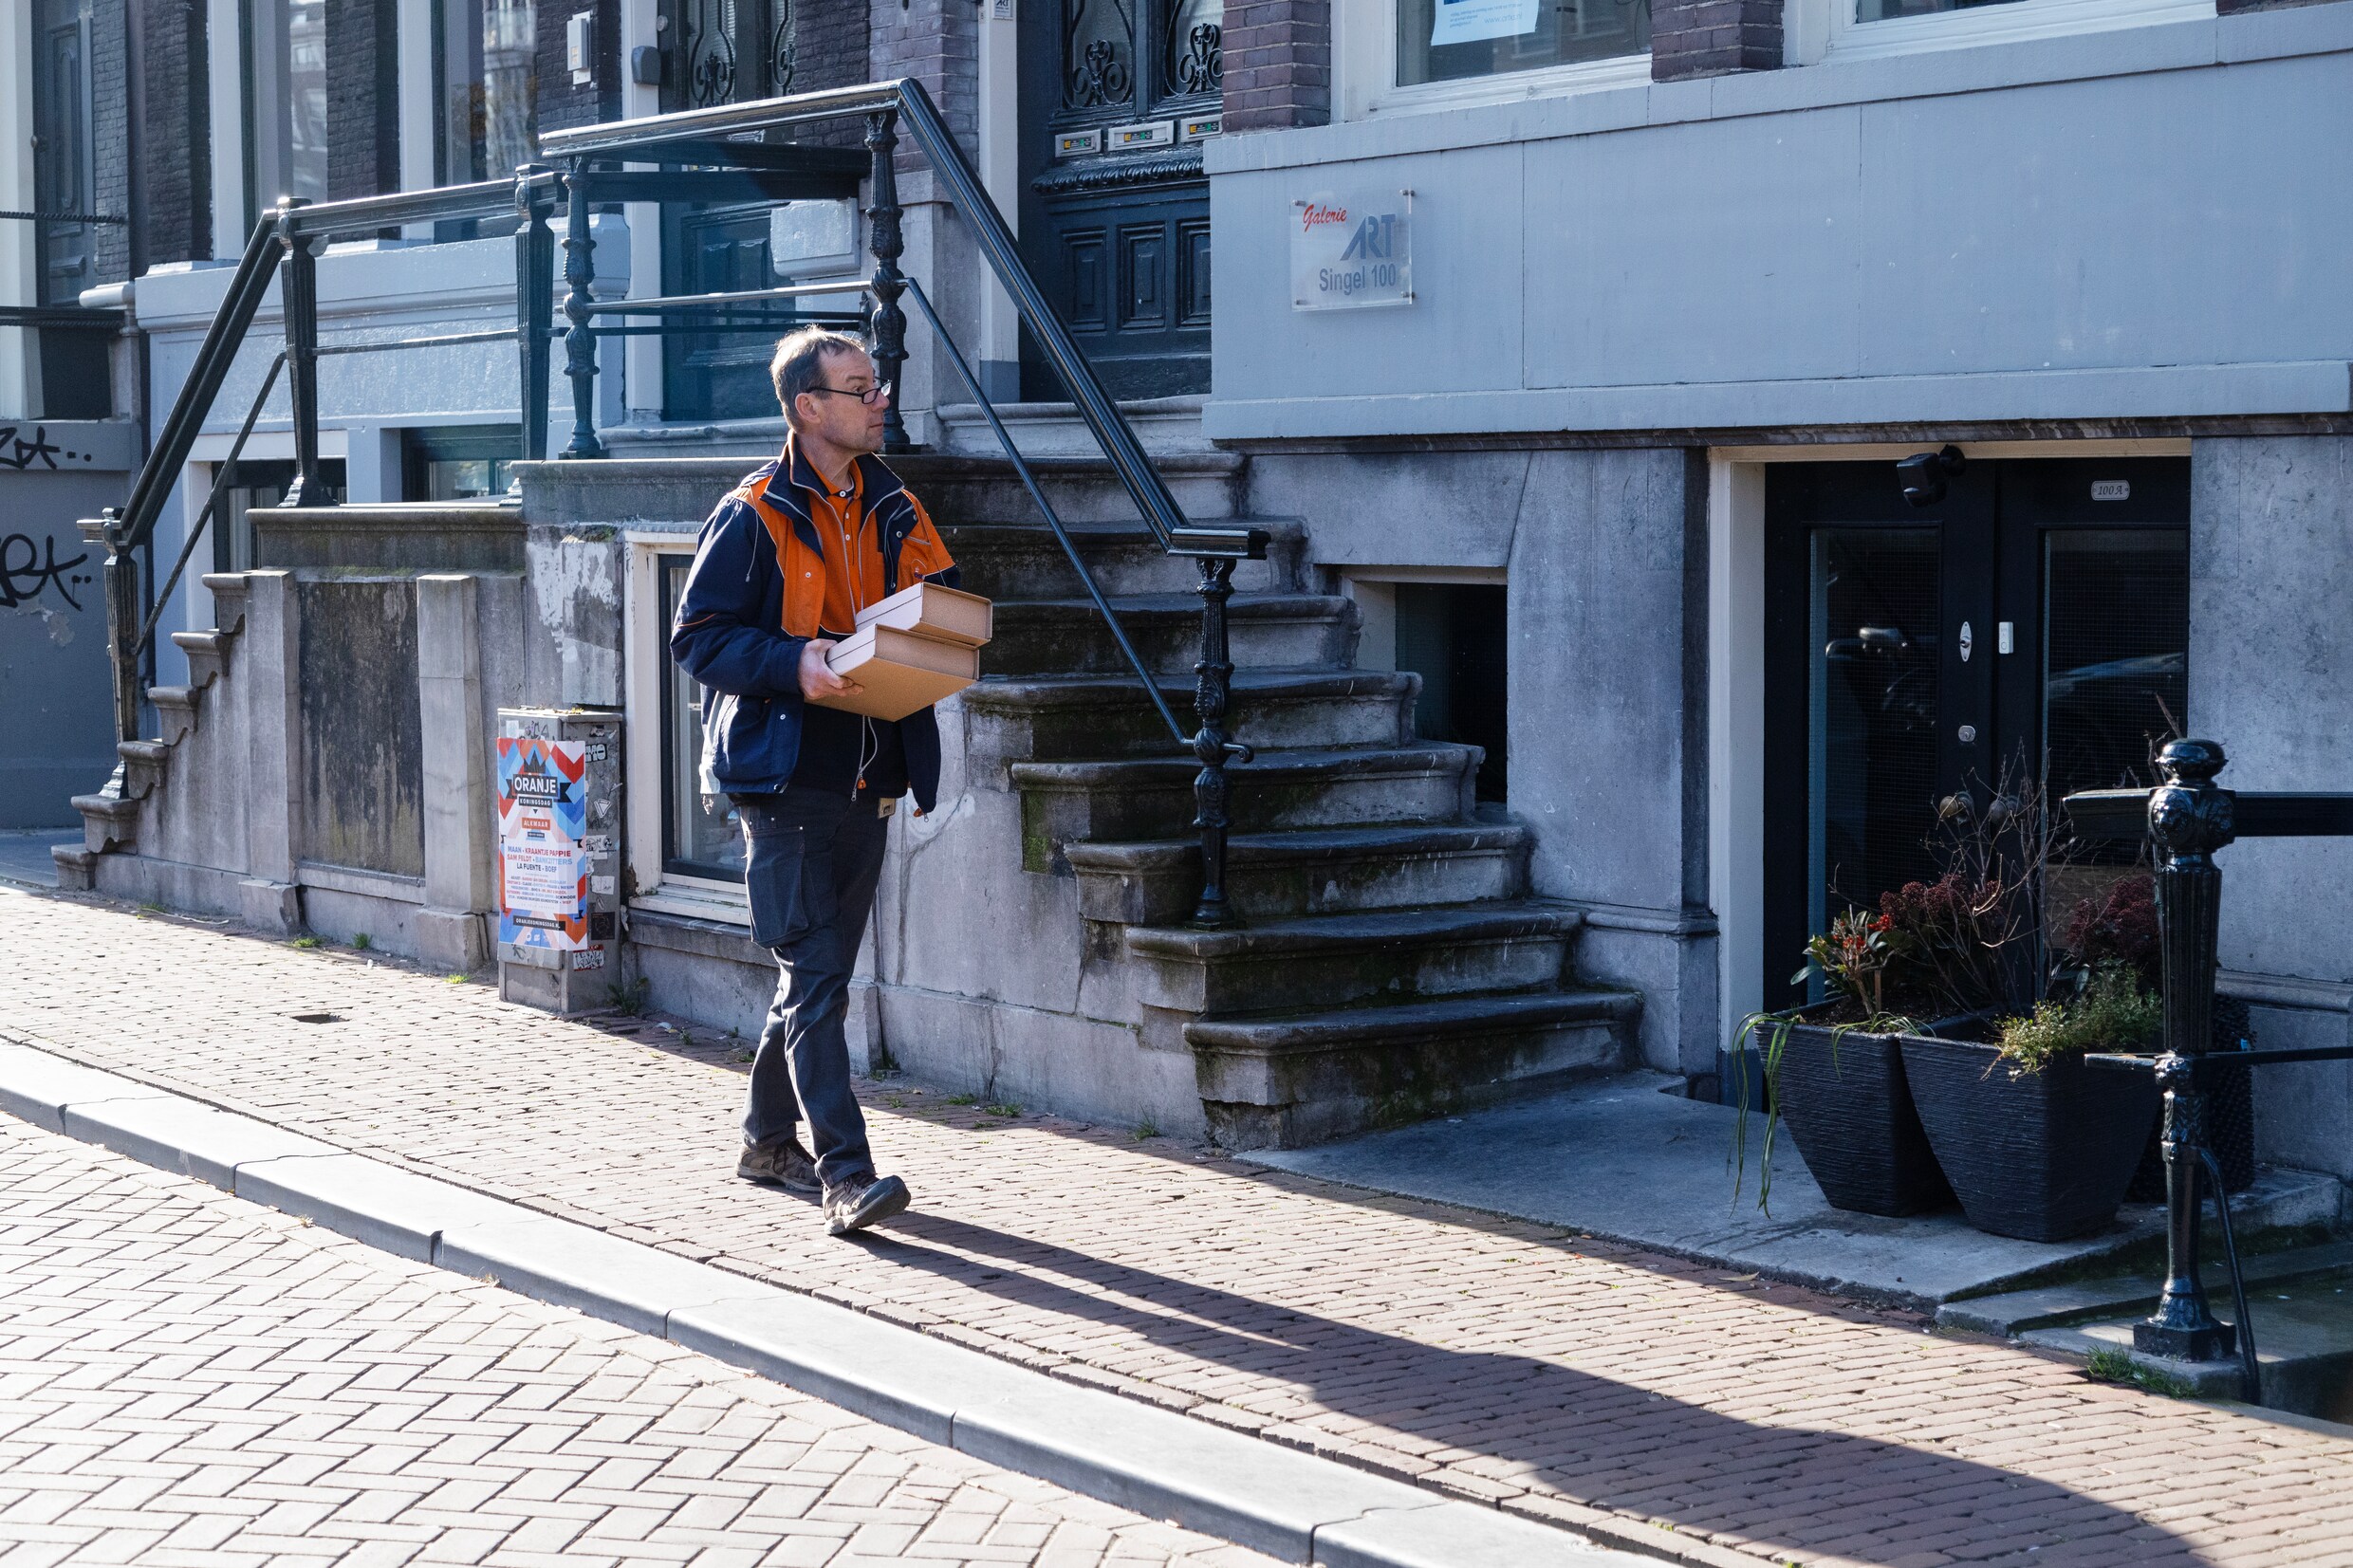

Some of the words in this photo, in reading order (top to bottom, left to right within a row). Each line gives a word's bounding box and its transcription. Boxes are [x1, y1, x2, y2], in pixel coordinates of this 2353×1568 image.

[1303, 204, 1347, 232] Galerie
[1340, 213, 1396, 261] ART
[1319, 265, 1366, 296] Singel
[1371, 263, 1397, 287] 100
[514, 776, 557, 794] ORANJE
[519, 798, 551, 806] KONINGSDAG
[523, 820, 548, 828] ALKMAAR
[525, 847, 548, 856] KRAANTJE
[524, 863, 541, 872] FUENTE
[515, 917, 561, 929] ORANJEKONINGSDAG.NL
